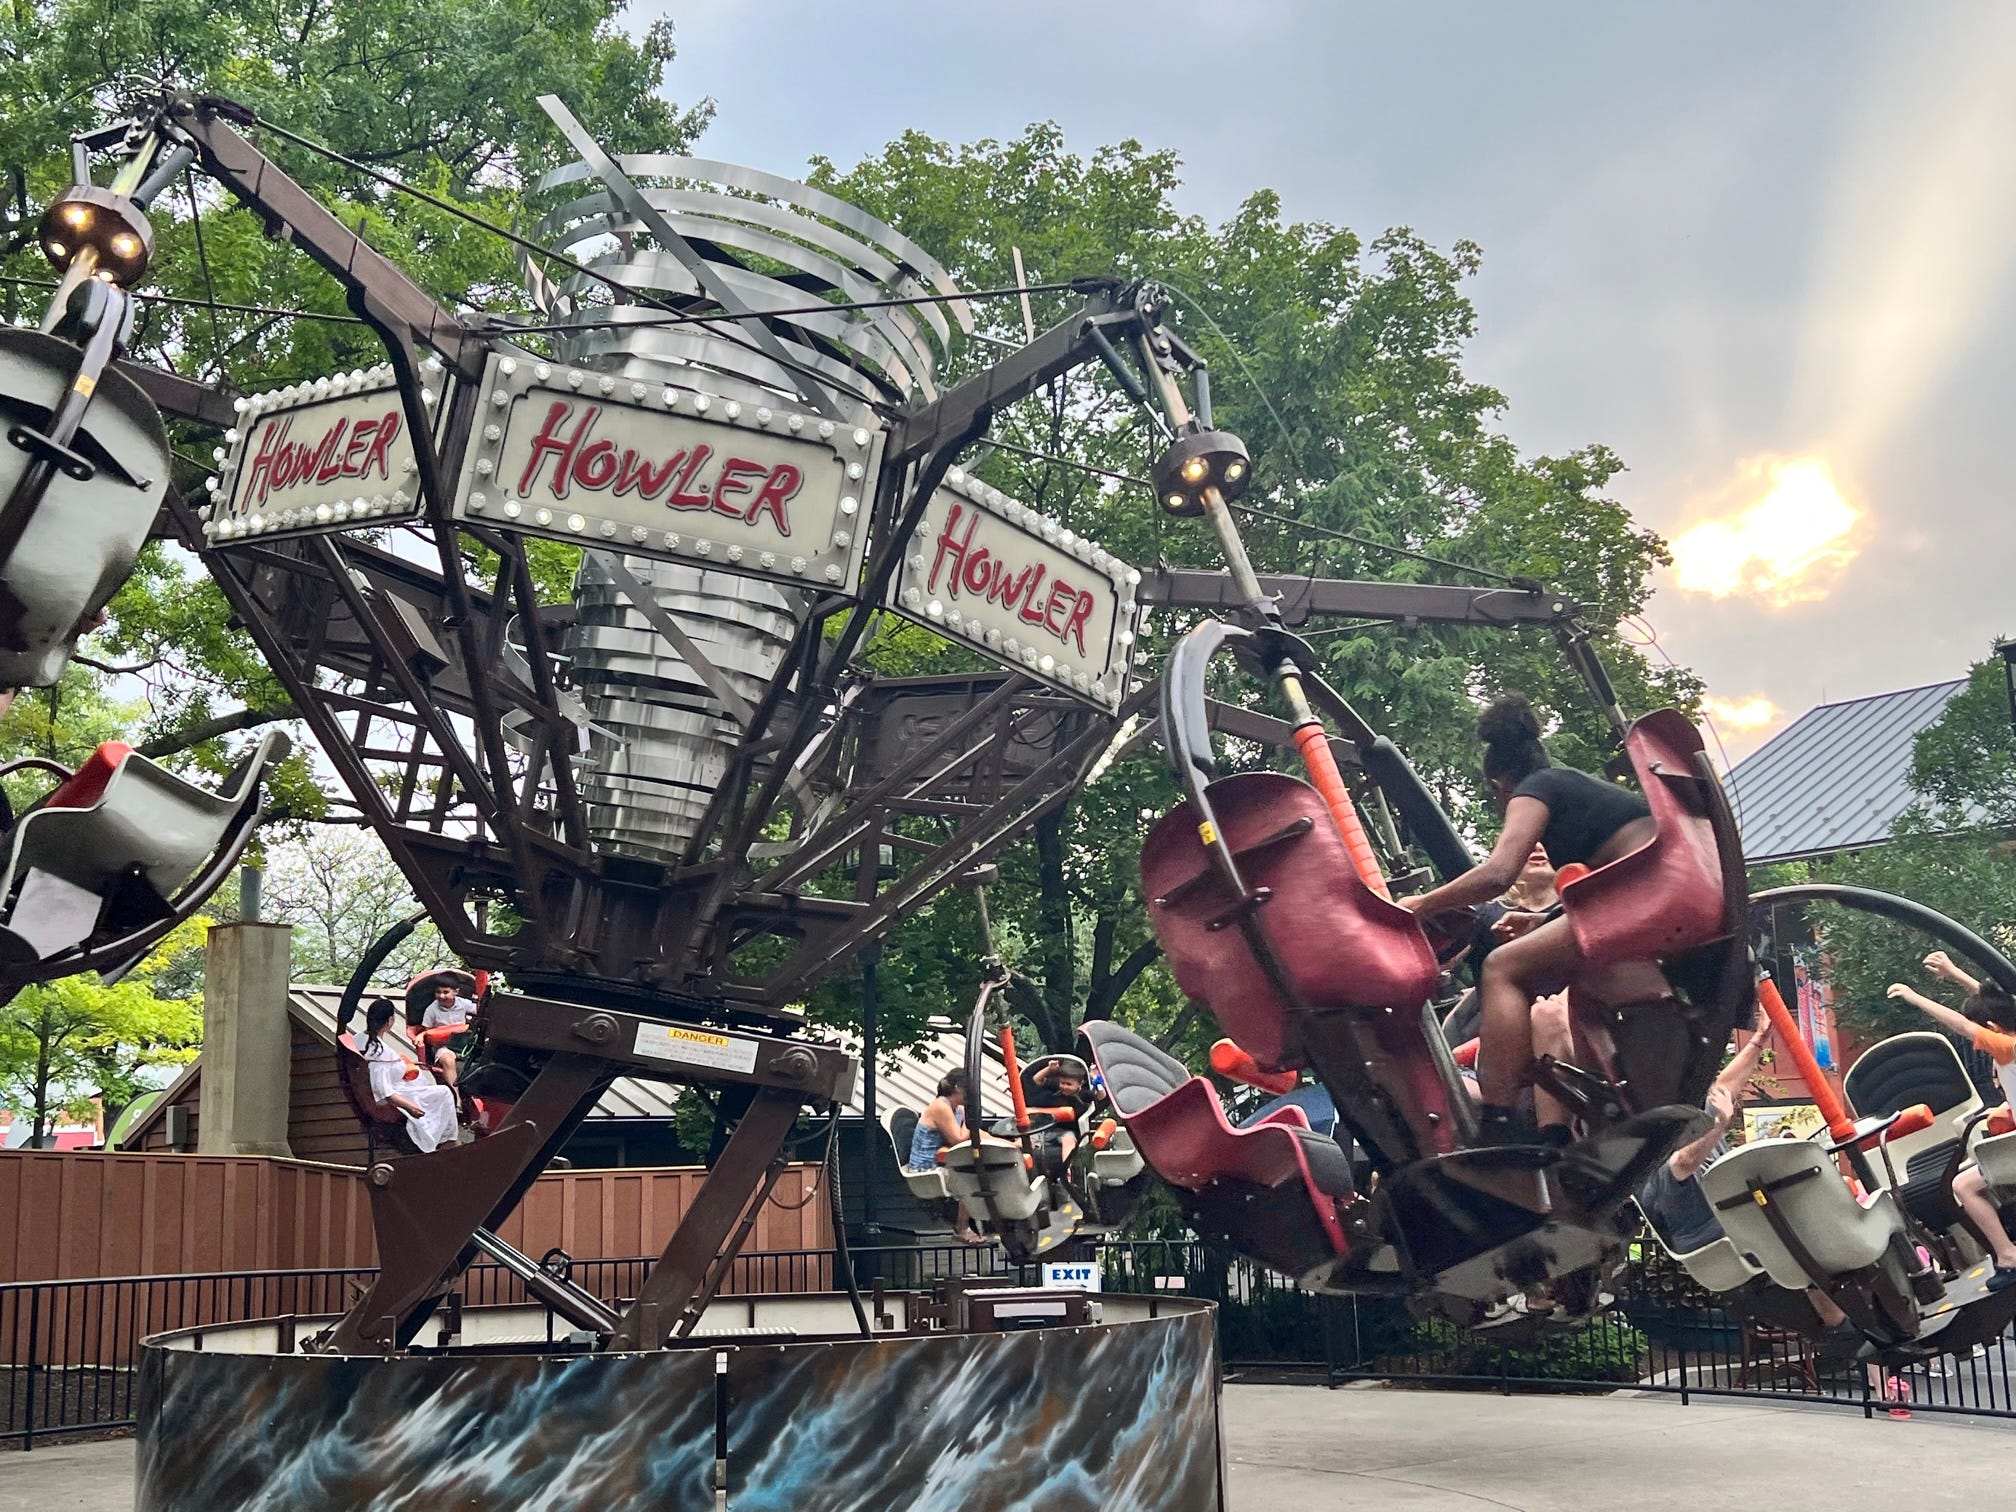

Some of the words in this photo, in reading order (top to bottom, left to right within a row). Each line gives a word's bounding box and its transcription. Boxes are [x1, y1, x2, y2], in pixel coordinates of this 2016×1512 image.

[241, 411, 401, 514] HOWLER
[517, 400, 804, 537] HOWLER
[928, 503, 1095, 657] HOWLER
[673, 1030, 724, 1045] DANGER
[1052, 1268, 1091, 1280] EXIT
